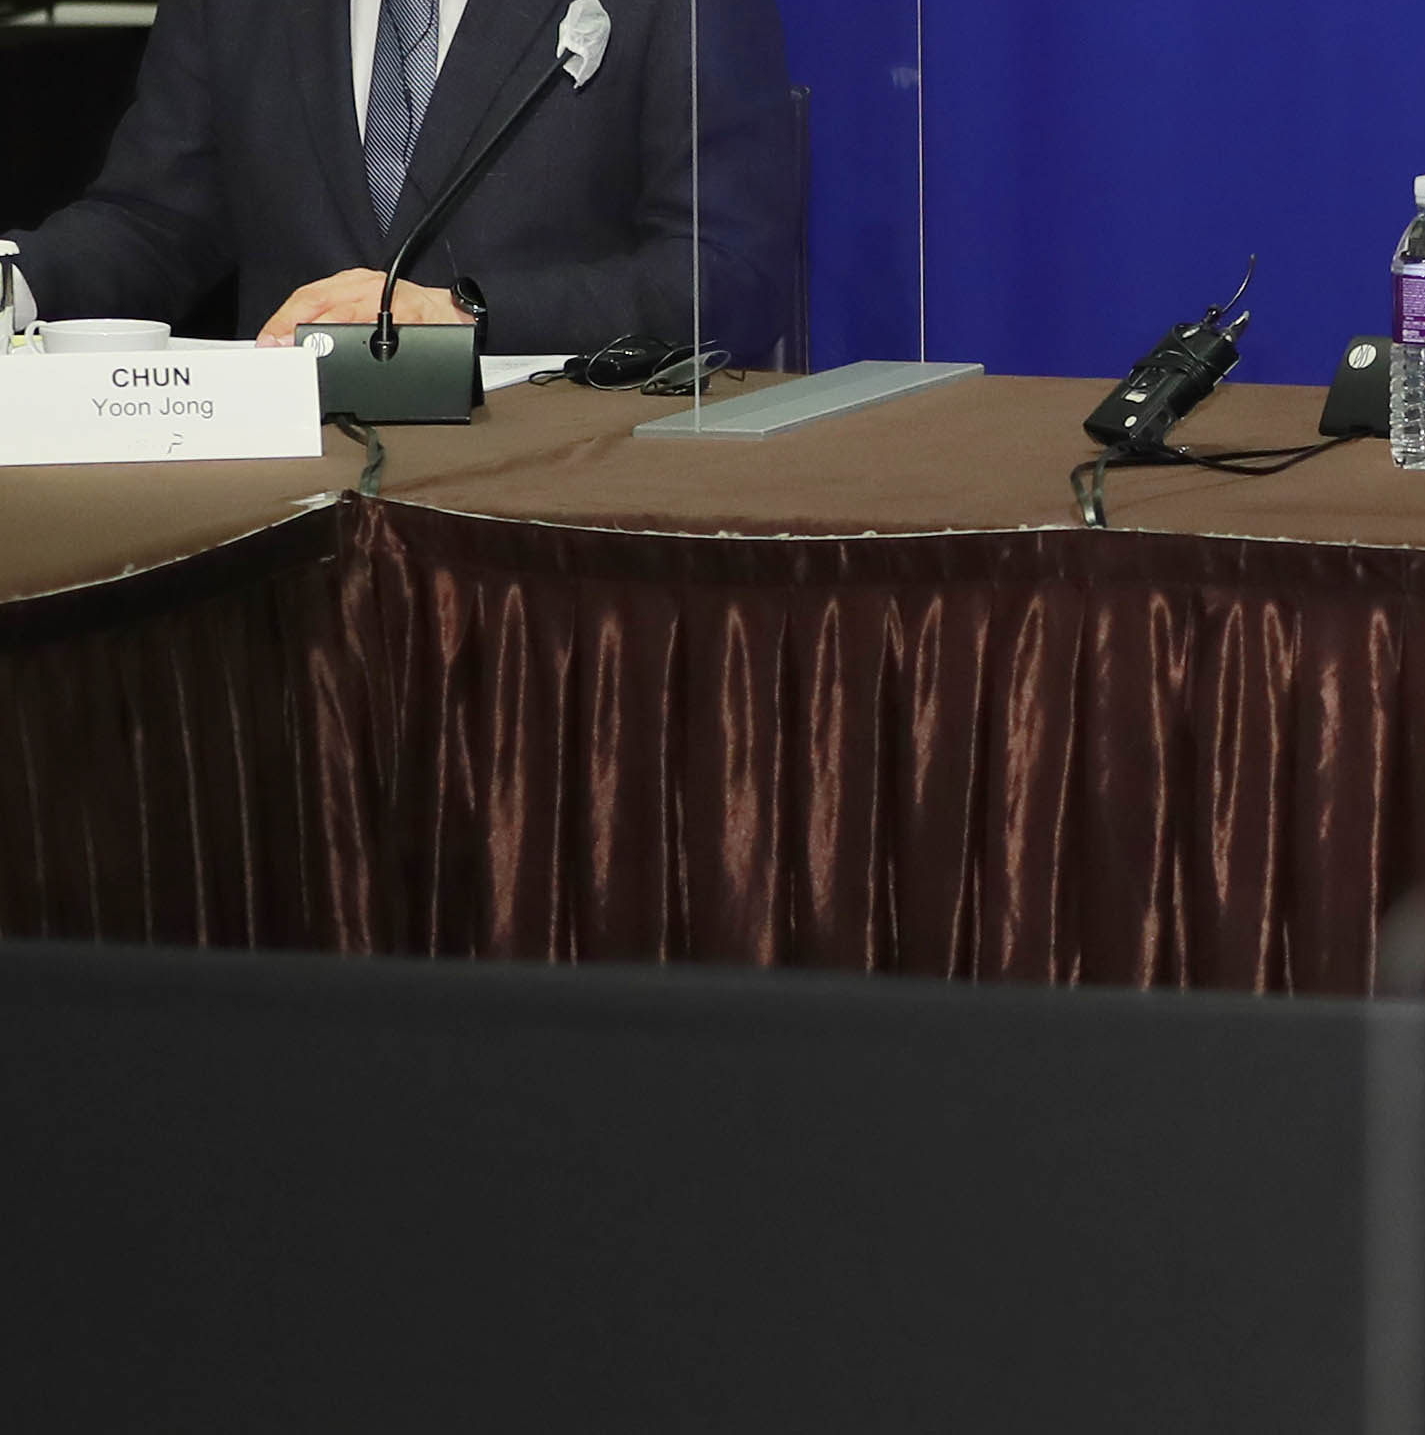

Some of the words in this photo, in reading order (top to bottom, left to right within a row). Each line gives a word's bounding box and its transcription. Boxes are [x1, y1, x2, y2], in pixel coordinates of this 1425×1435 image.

[110, 366, 192, 388] CHUN
[91, 397, 151, 417] Yoon
[158, 396, 214, 420] Jong
